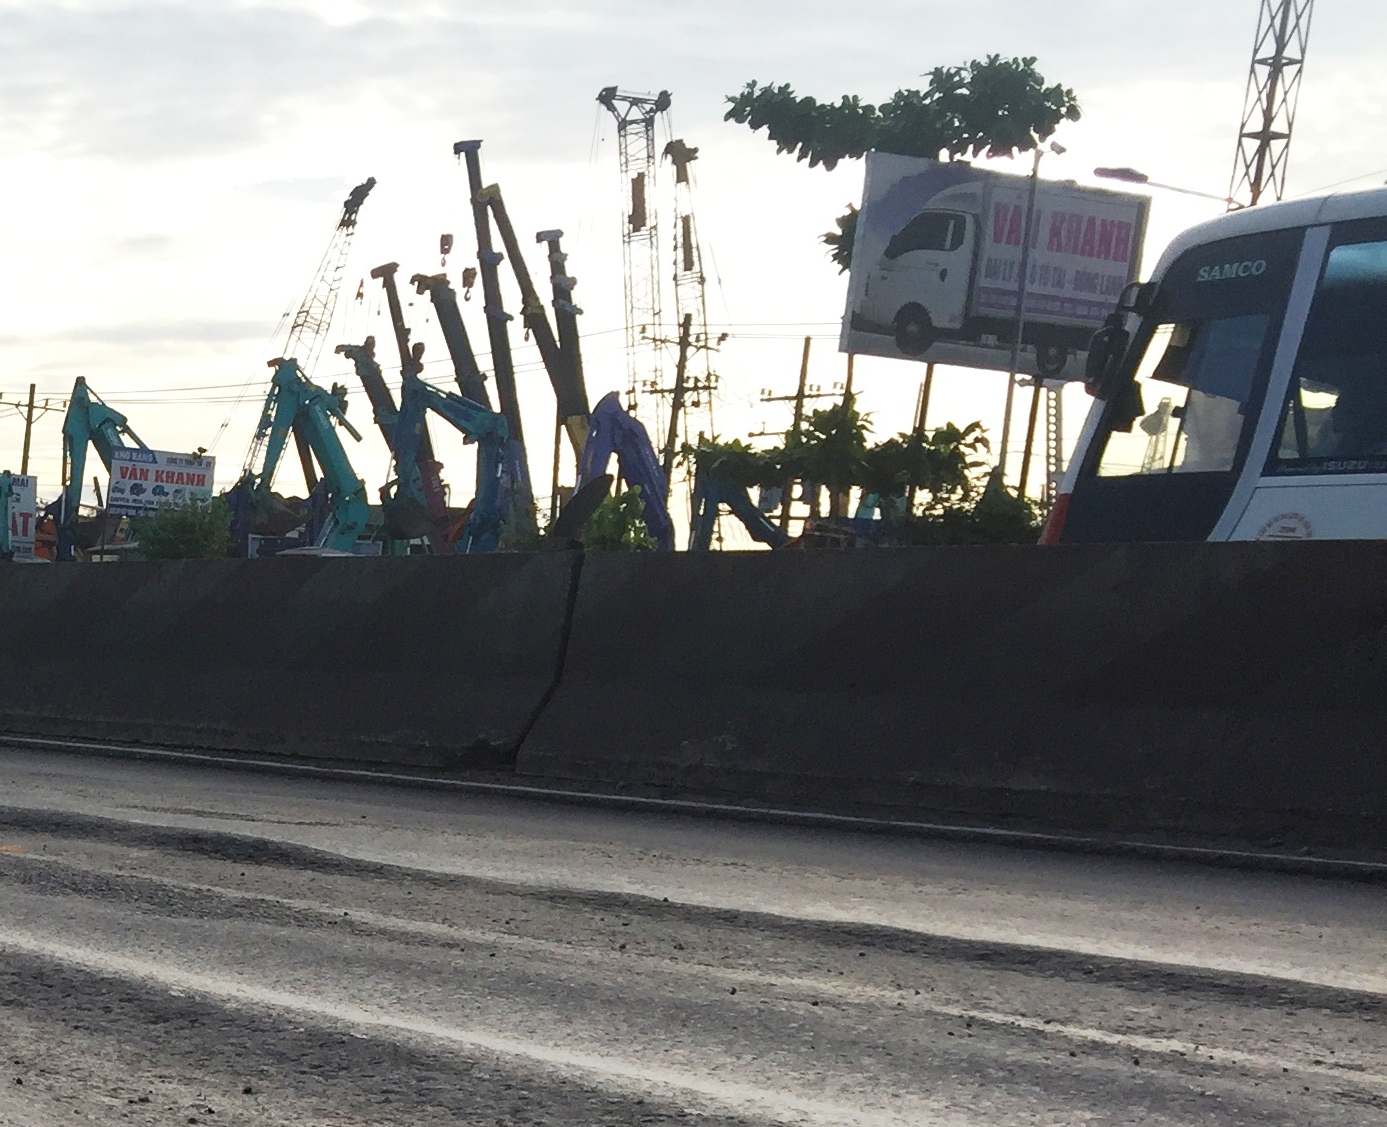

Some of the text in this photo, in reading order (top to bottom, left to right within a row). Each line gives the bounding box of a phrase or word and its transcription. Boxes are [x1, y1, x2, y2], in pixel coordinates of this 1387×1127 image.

[1047, 211, 1132, 263] KHANH
[1197, 260, 1267, 281] SAMCO
[154, 469, 206, 487] KHANH
